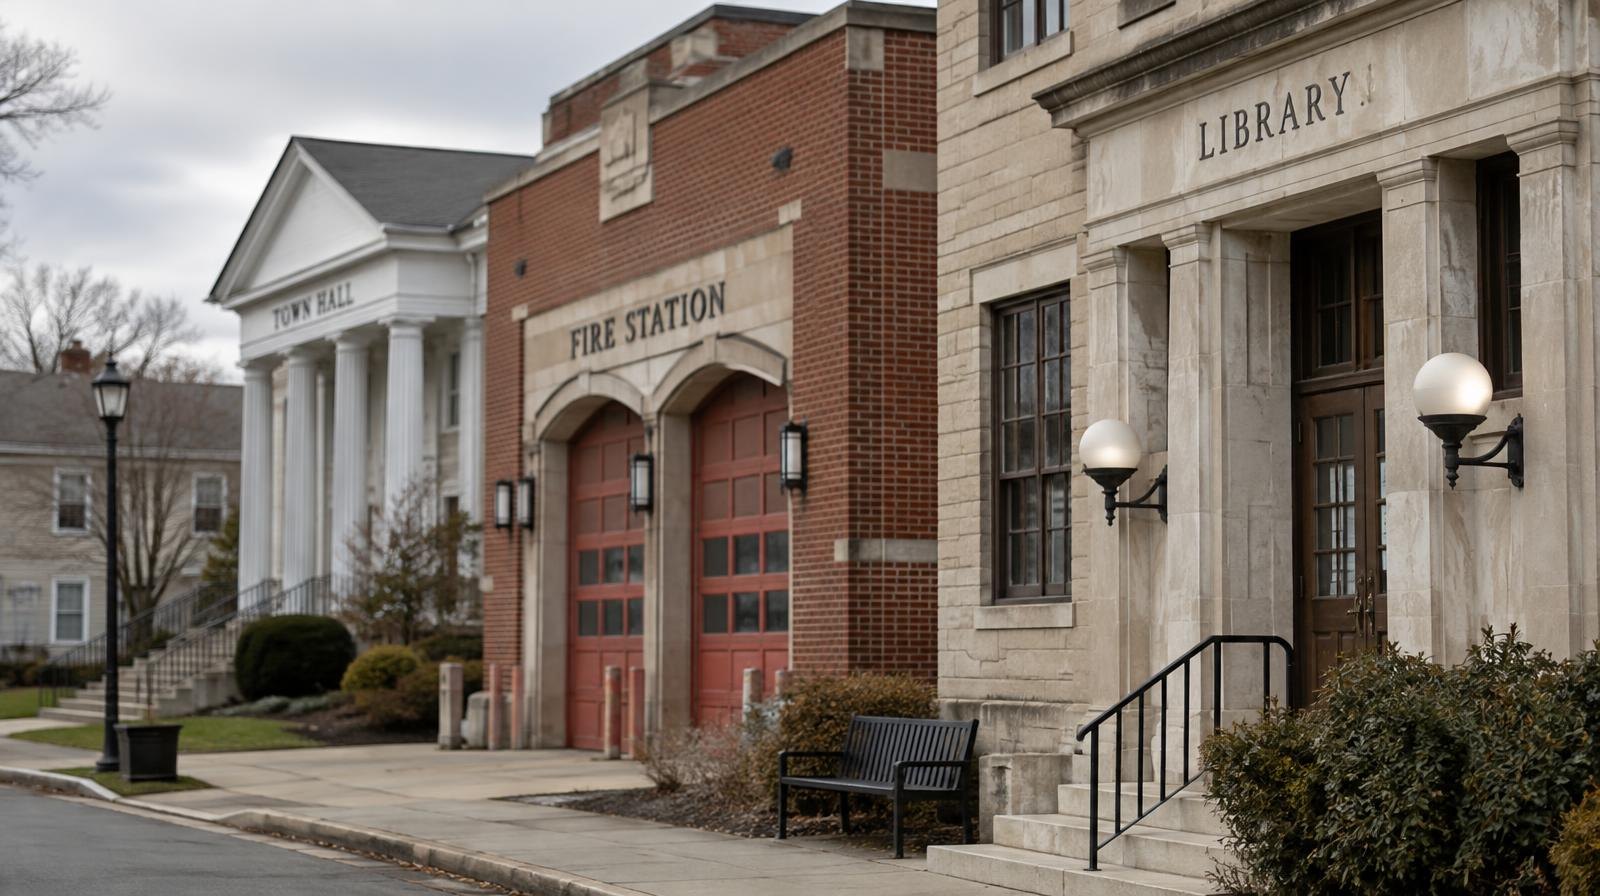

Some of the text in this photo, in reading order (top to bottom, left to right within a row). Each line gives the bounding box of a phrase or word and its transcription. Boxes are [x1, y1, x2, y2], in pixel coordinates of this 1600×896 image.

[272, 281, 355, 331] TOWN HALL
[570, 281, 726, 361] FIRE STATION
